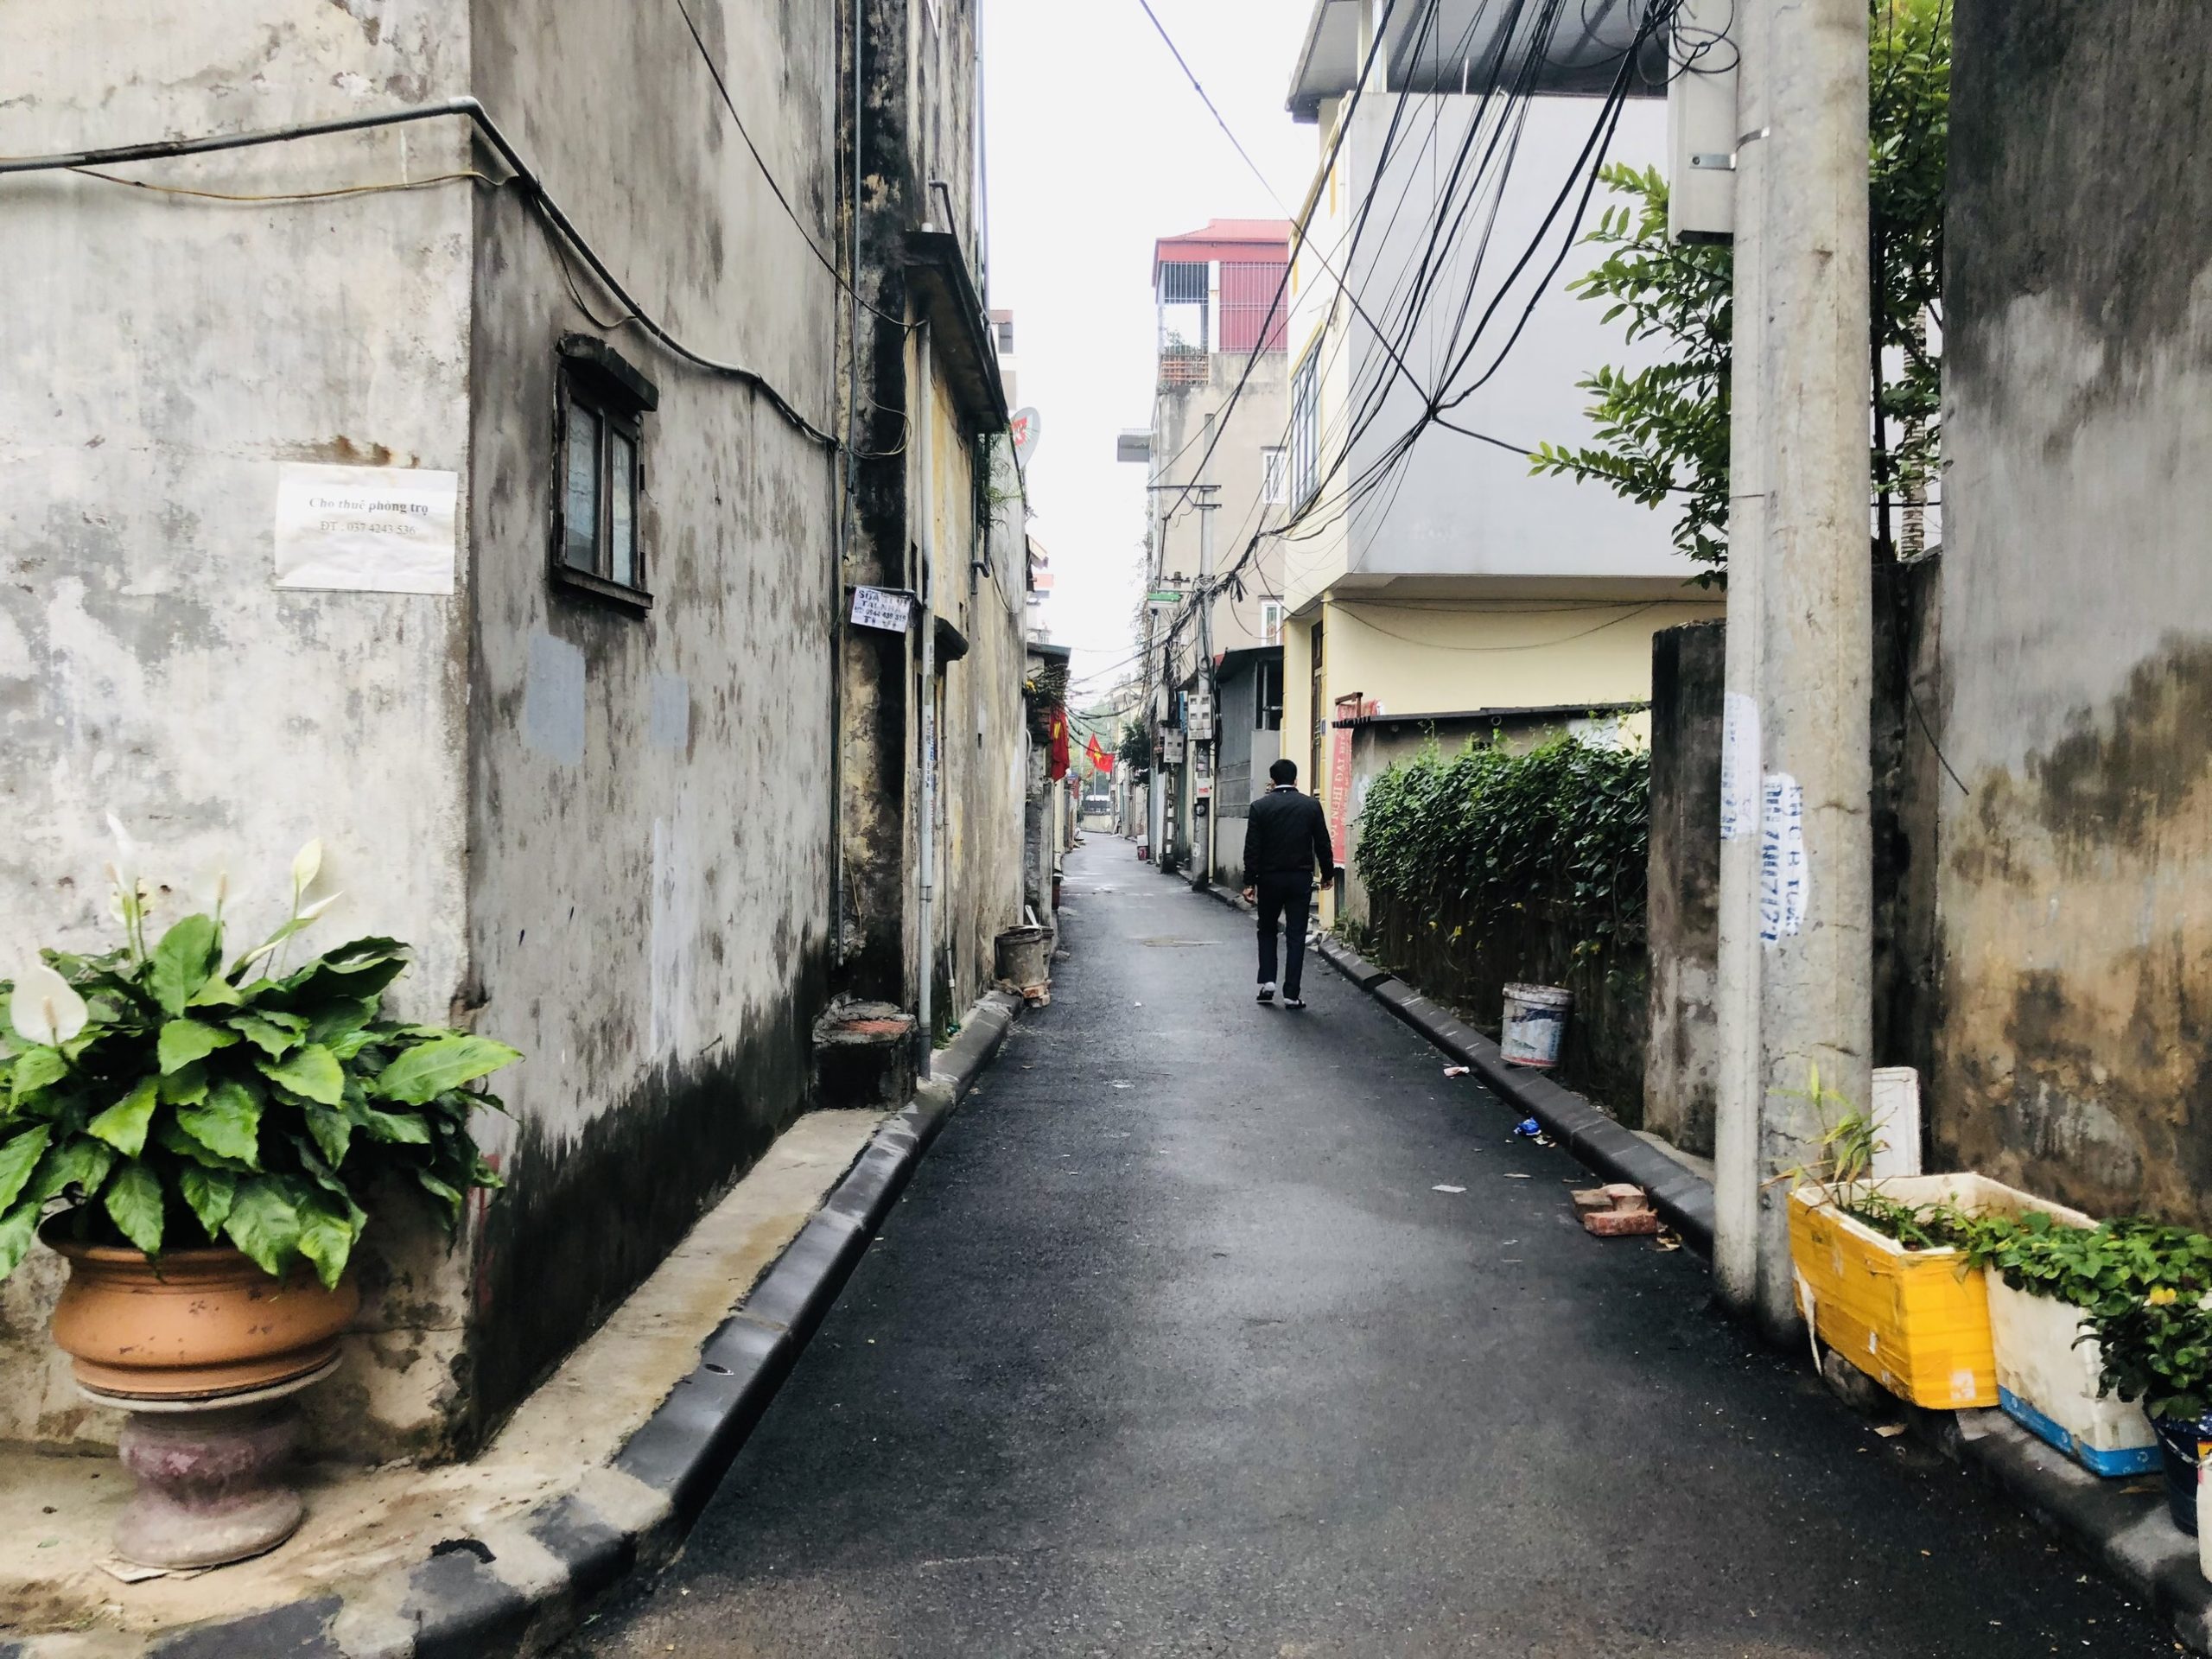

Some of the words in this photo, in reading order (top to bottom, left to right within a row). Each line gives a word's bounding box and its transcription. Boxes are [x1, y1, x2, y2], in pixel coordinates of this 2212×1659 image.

[309, 498, 334, 508] Cho
[368, 500, 407, 514] phòng
[410, 503, 429, 517] trọ
[321, 521, 338, 531] ĐT
[347, 522, 365, 532] 037
[369, 524, 393, 534] 4243
[397, 524, 416, 536] 536
